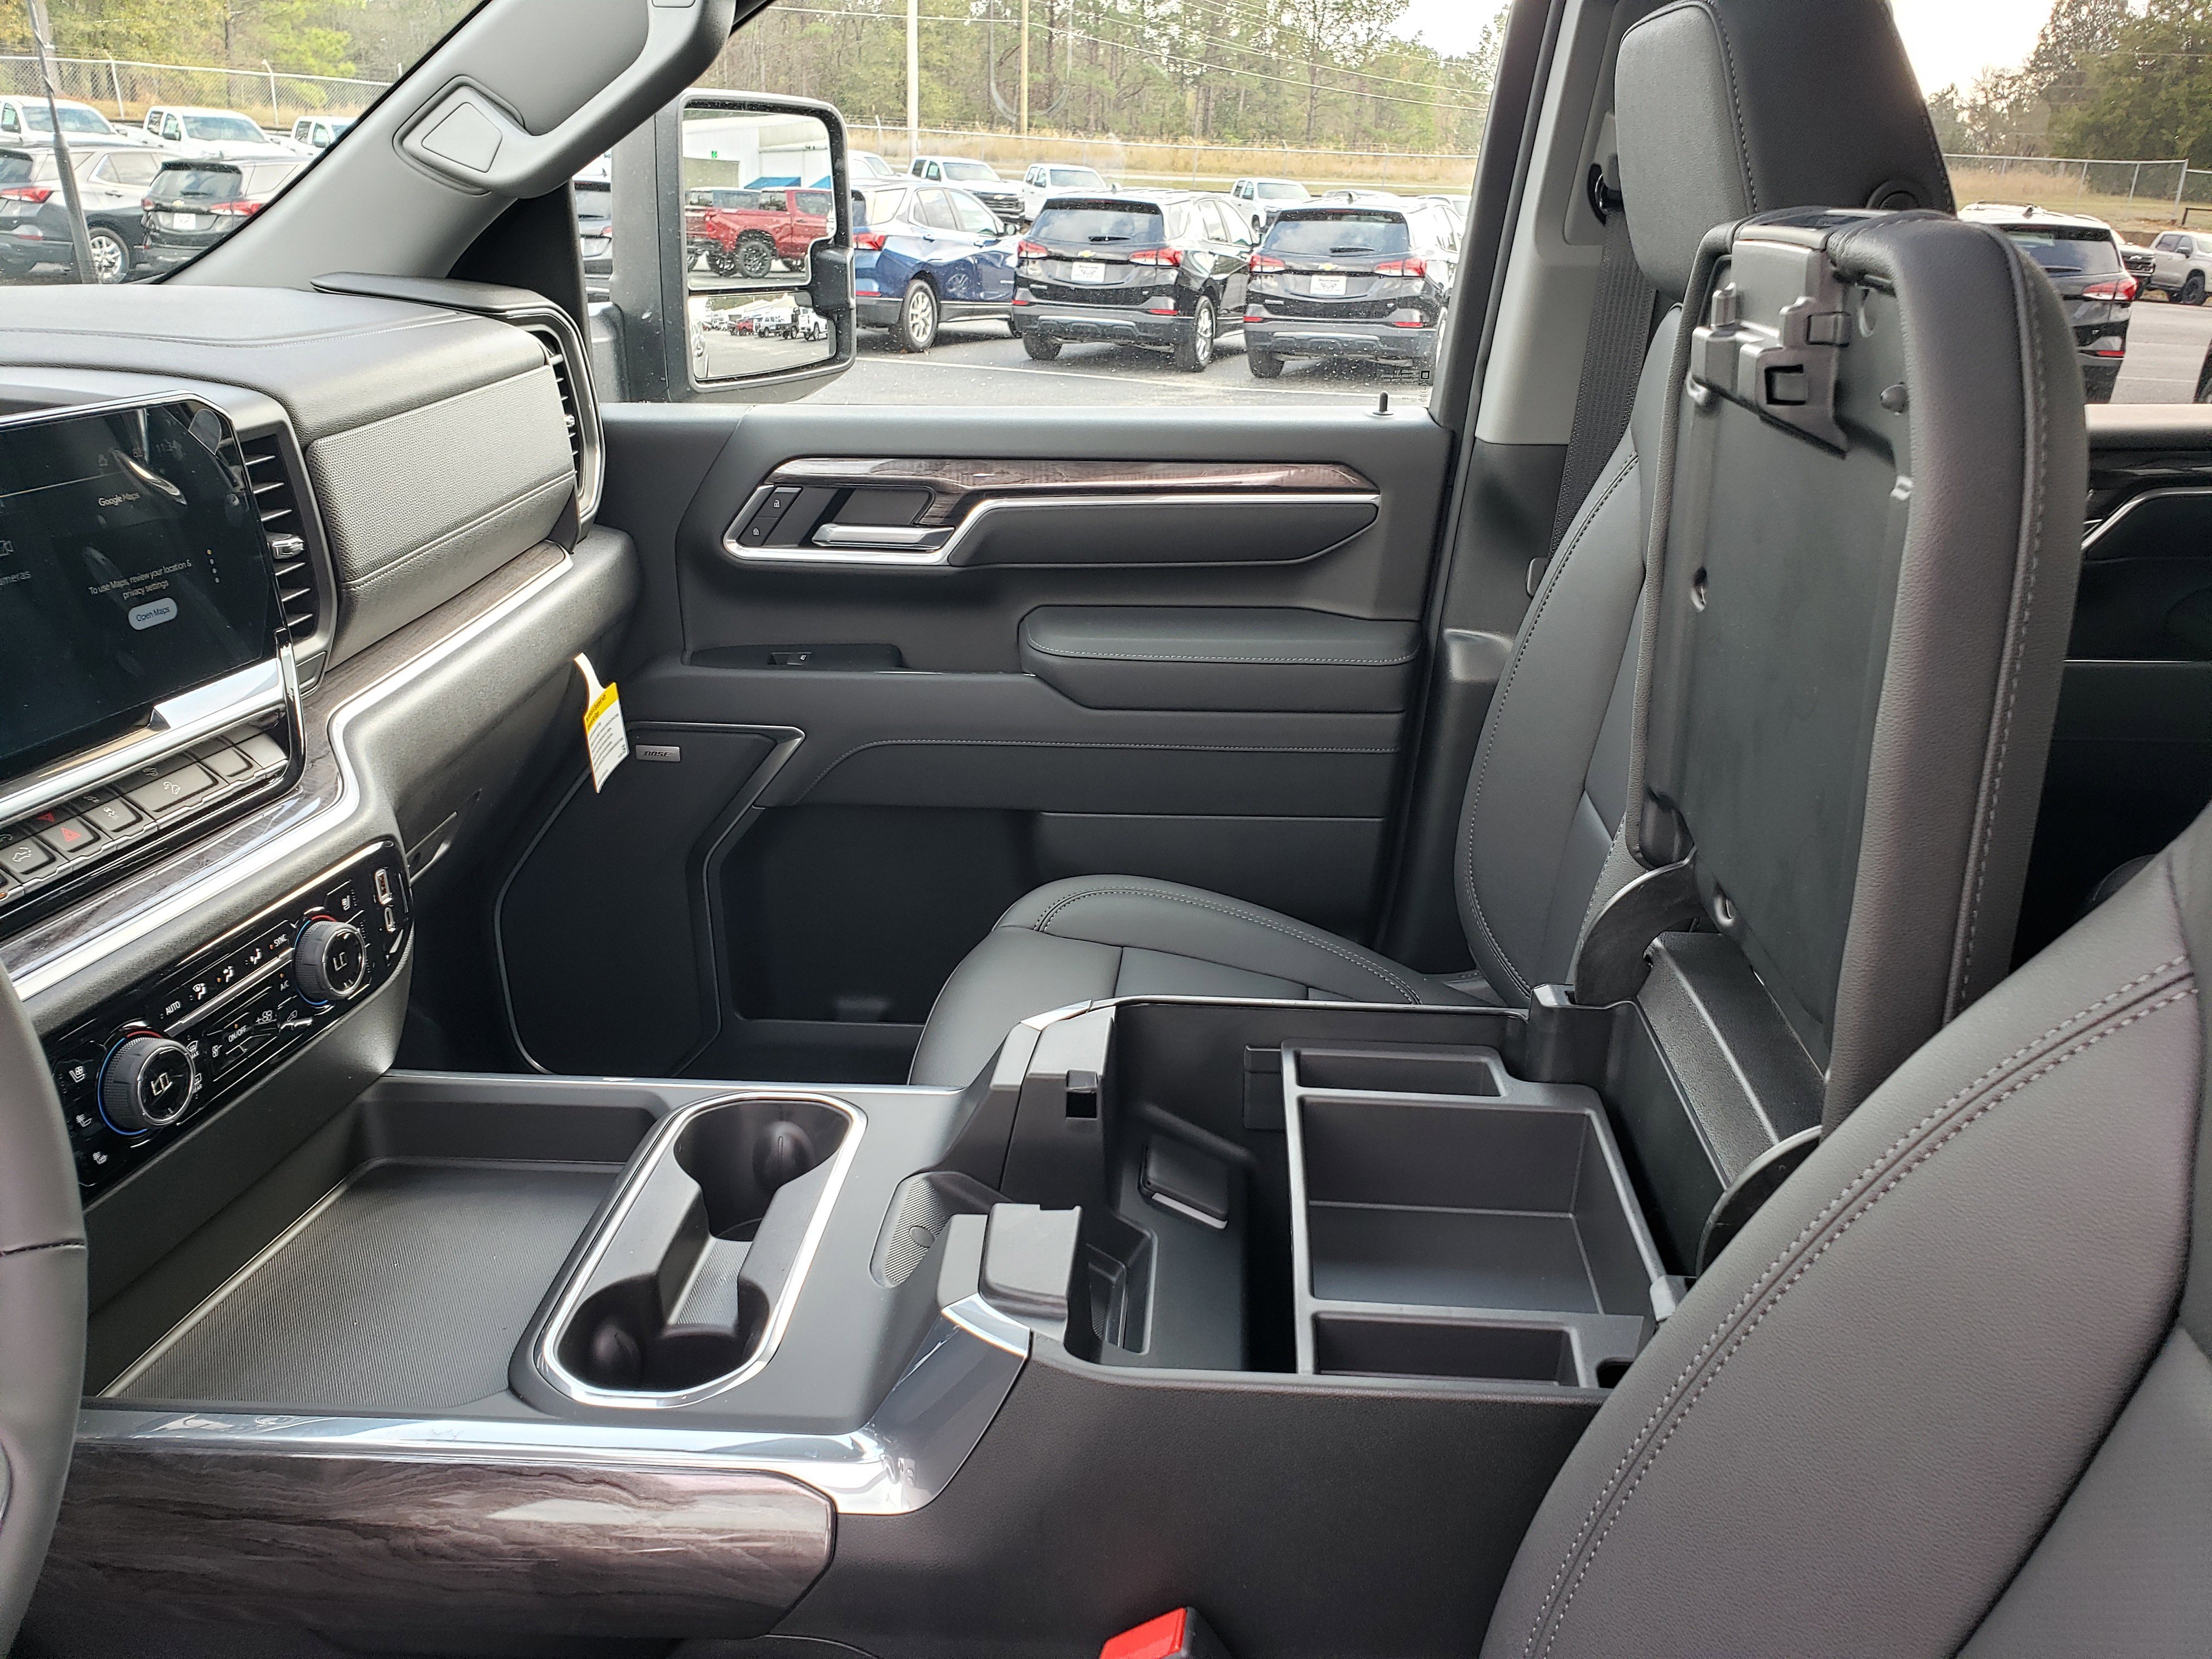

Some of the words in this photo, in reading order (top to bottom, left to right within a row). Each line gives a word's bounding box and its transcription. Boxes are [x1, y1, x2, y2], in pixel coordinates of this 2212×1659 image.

[98, 494, 123, 506] Google
[88, 586, 98, 595] To
[98, 584, 110, 593] use
[129, 573, 149, 583] review
[149, 568, 163, 580] your
[163, 561, 187, 573] location
[123, 588, 145, 600] privacy
[145, 579, 169, 592] settings
[136, 611, 154, 622] Open
[154, 606, 170, 617] Maps
[274, 934, 287, 947] SYNC
[280, 980, 290, 991] A/C
[165, 1001, 181, 1015] AUTO
[228, 1025, 247, 1043] ON/OFF
